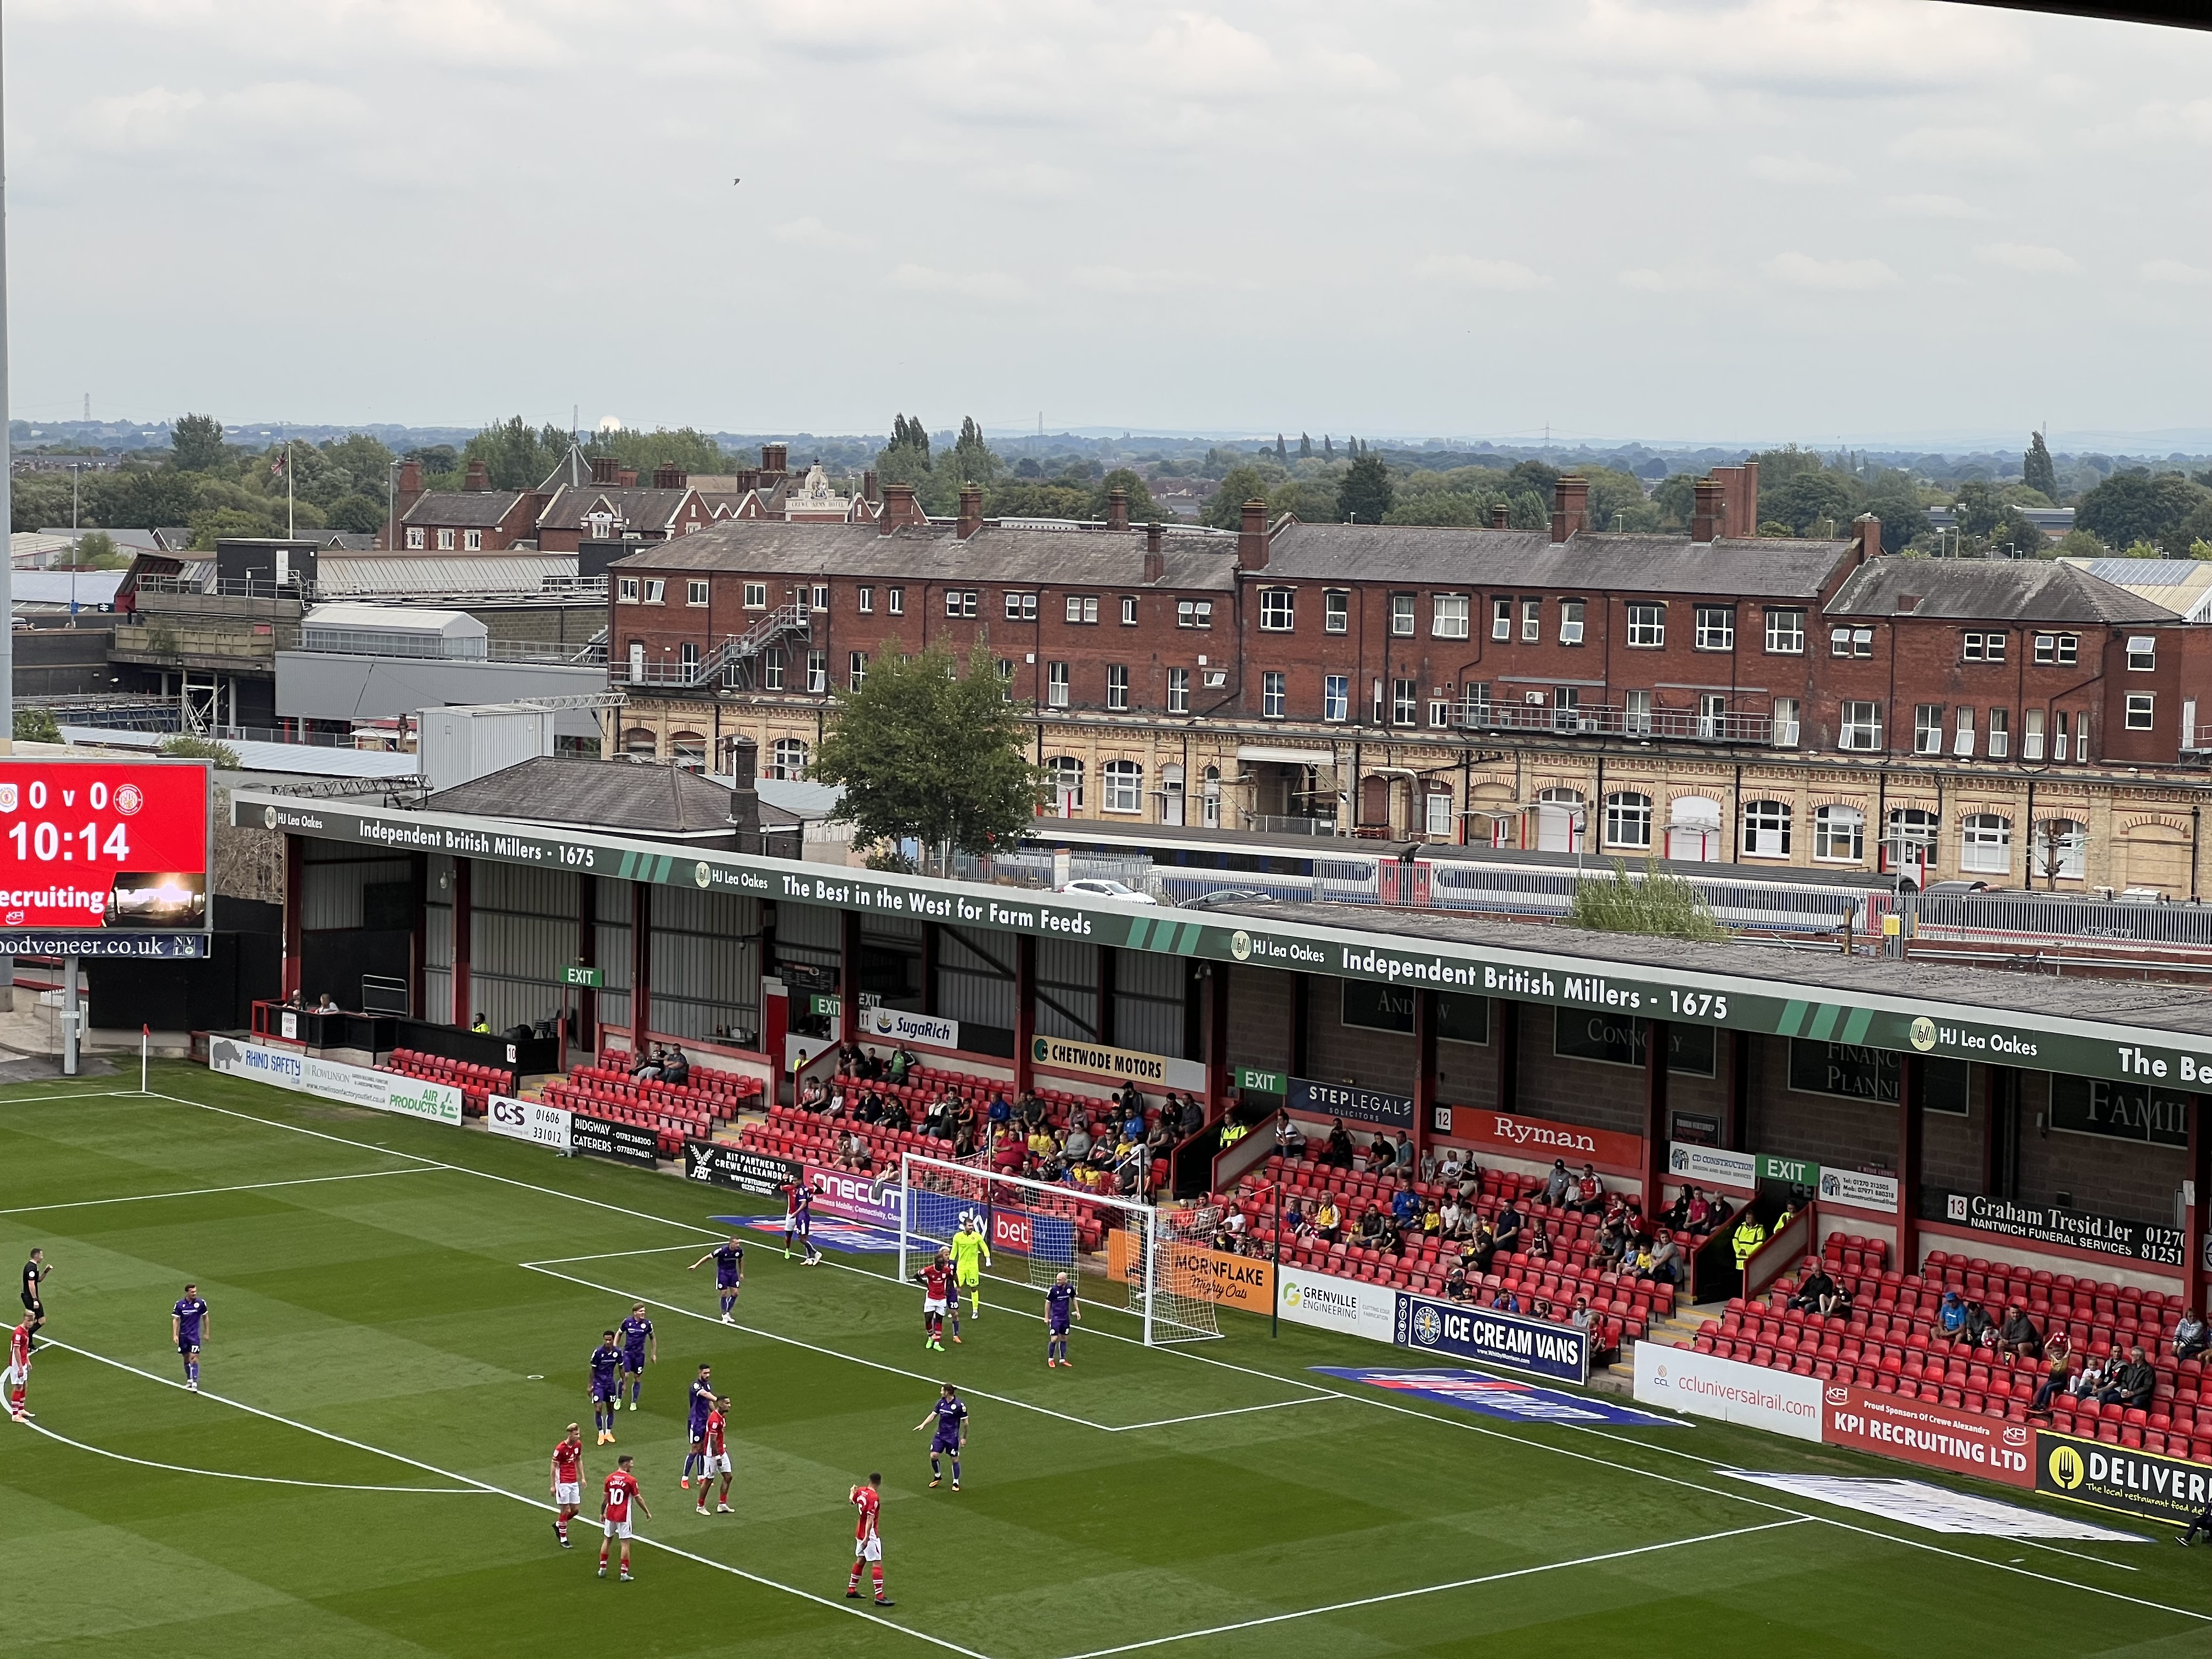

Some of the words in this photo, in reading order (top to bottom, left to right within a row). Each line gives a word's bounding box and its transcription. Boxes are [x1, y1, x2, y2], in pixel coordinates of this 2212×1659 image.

[29, 781, 47, 809] 0
[62, 789, 76, 807] v
[89, 781, 108, 810] 0
[278, 812, 286, 825] HJ
[288, 814, 300, 826] Lea
[301, 815, 323, 829] Oakes
[9, 822, 129, 861] 10:14
[360, 820, 441, 846] Independent
[445, 830, 489, 853] British
[495, 837, 541, 860] Millers
[558, 845, 594, 867] 1675
[712, 868, 723, 883] HJ
[725, 871, 738, 885] Lea
[741, 873, 768, 889] Oakes
[782, 876, 810, 897] The
[816, 880, 849, 902] Best
[855, 884, 870, 905] in
[877, 887, 902, 910] the
[909, 891, 951, 916] West
[957, 897, 983, 920] for
[990, 902, 1033, 927] Farm
[1041, 909, 1092, 934] Feeds
[1253, 939, 1266, 956] HJ
[1269, 941, 1286, 958] Lea
[1290, 944, 1325, 963] Oakes
[568, 968, 593, 985] EXIT
[1342, 947, 1476, 985] Independent
[1485, 966, 1554, 997] British
[1564, 977, 1640, 1009] Millers
[1671, 990, 1727, 1019] 1675
[819, 998, 840, 1015] EXIT
[861, 1013, 868, 1026] 11
[896, 1017, 950, 1041] SugaRich
[1939, 1026, 1957, 1046] HJ
[1962, 1030, 1986, 1049] Lea
[1990, 1034, 2038, 1056] Oakes
[246, 1049, 268, 1069] RHINO
[271, 1056, 300, 1076] SAFETY
[508, 1048, 516, 1059] 10
[1052, 1045, 1110, 1070] CHETWODE
[1114, 1056, 1161, 1079] MOTORS
[2119, 1047, 2168, 1077] The
[312, 1065, 350, 1084] ROWLINSON
[1245, 1071, 1276, 1091] EXIT
[390, 1094, 438, 1115] PRODUCTS
[422, 1089, 438, 1102] AIR
[1309, 1086, 1401, 1115] STEPLEGAL
[494, 1101, 525, 1126] OSS
[536, 1109, 560, 1124] 01606
[1329, 1107, 1379, 1122] SOLICITORS
[1437, 1111, 1449, 1126] 12
[533, 1127, 561, 1143] 331012
[574, 1118, 610, 1136] RIDGWAY
[1493, 1116, 1596, 1153] Ryman
[573, 1135, 612, 1153] CATERERS
[715, 1159, 741, 1171] CREWE
[742, 1164, 782, 1181] ALEXANDR
[726, 1152, 738, 1161] KIT
[740, 1155, 775, 1170] PARTNER
[776, 1163, 786, 1172] TO
[1692, 1154, 1701, 1162] CD
[1702, 1156, 1754, 1171] CONSTRUCTION
[1767, 1158, 1806, 1181] EXIT
[813, 1173, 902, 1209] onecom
[813, 1195, 835, 1207] Business
[887, 1213, 901, 1222] Clou
[1950, 1199, 1964, 1216] 13
[1972, 1196, 2042, 1226] Graham
[997, 1215, 1028, 1244] bet
[1971, 1217, 2025, 1237] NANTWICH
[2029, 1228, 2077, 1246] FUNERAL
[2079, 1237, 2132, 1256] SERVICES
[2141, 1243, 2182, 1265] 81251
[1175, 1254, 1263, 1286] MORNFLAKE
[1190, 1274, 1224, 1300] Mighty
[1225, 1283, 1247, 1299] Oats
[1304, 1287, 1357, 1308] GRENVILLE
[1303, 1300, 1356, 1319] ENGINEERING
[1362, 1304, 1379, 1313] CUTTING
[1363, 1312, 1389, 1321] FABRICATION
[1444, 1313, 1470, 1342] ICE
[1473, 1320, 1532, 1356] CREAM
[1536, 1333, 1579, 1365] VANS
[1654, 1378, 1669, 1387] CCL
[1679, 1375, 1816, 1419] ccluniversalrail.com
[1864, 1401, 1884, 1412] Proud
[1886, 1405, 1917, 1420] Sponsors
[1919, 1413, 1928, 1421] Of
[1929, 1415, 1951, 1427] Crewe
[1953, 1420, 1990, 1436] Alexandra
[1835, 1412, 1865, 1435] KPI
[1870, 1420, 1984, 1463] RECRUITING
[1990, 1447, 2027, 1472] LTD
[609, 1488, 624, 1505] 10
[2086, 1483, 2102, 1493] The
[2104, 1485, 2122, 1498] local
[2125, 1493, 2169, 1508] restaurant
[2171, 1500, 2188, 1512] food
[2192, 1504, 2206, 1515] del
